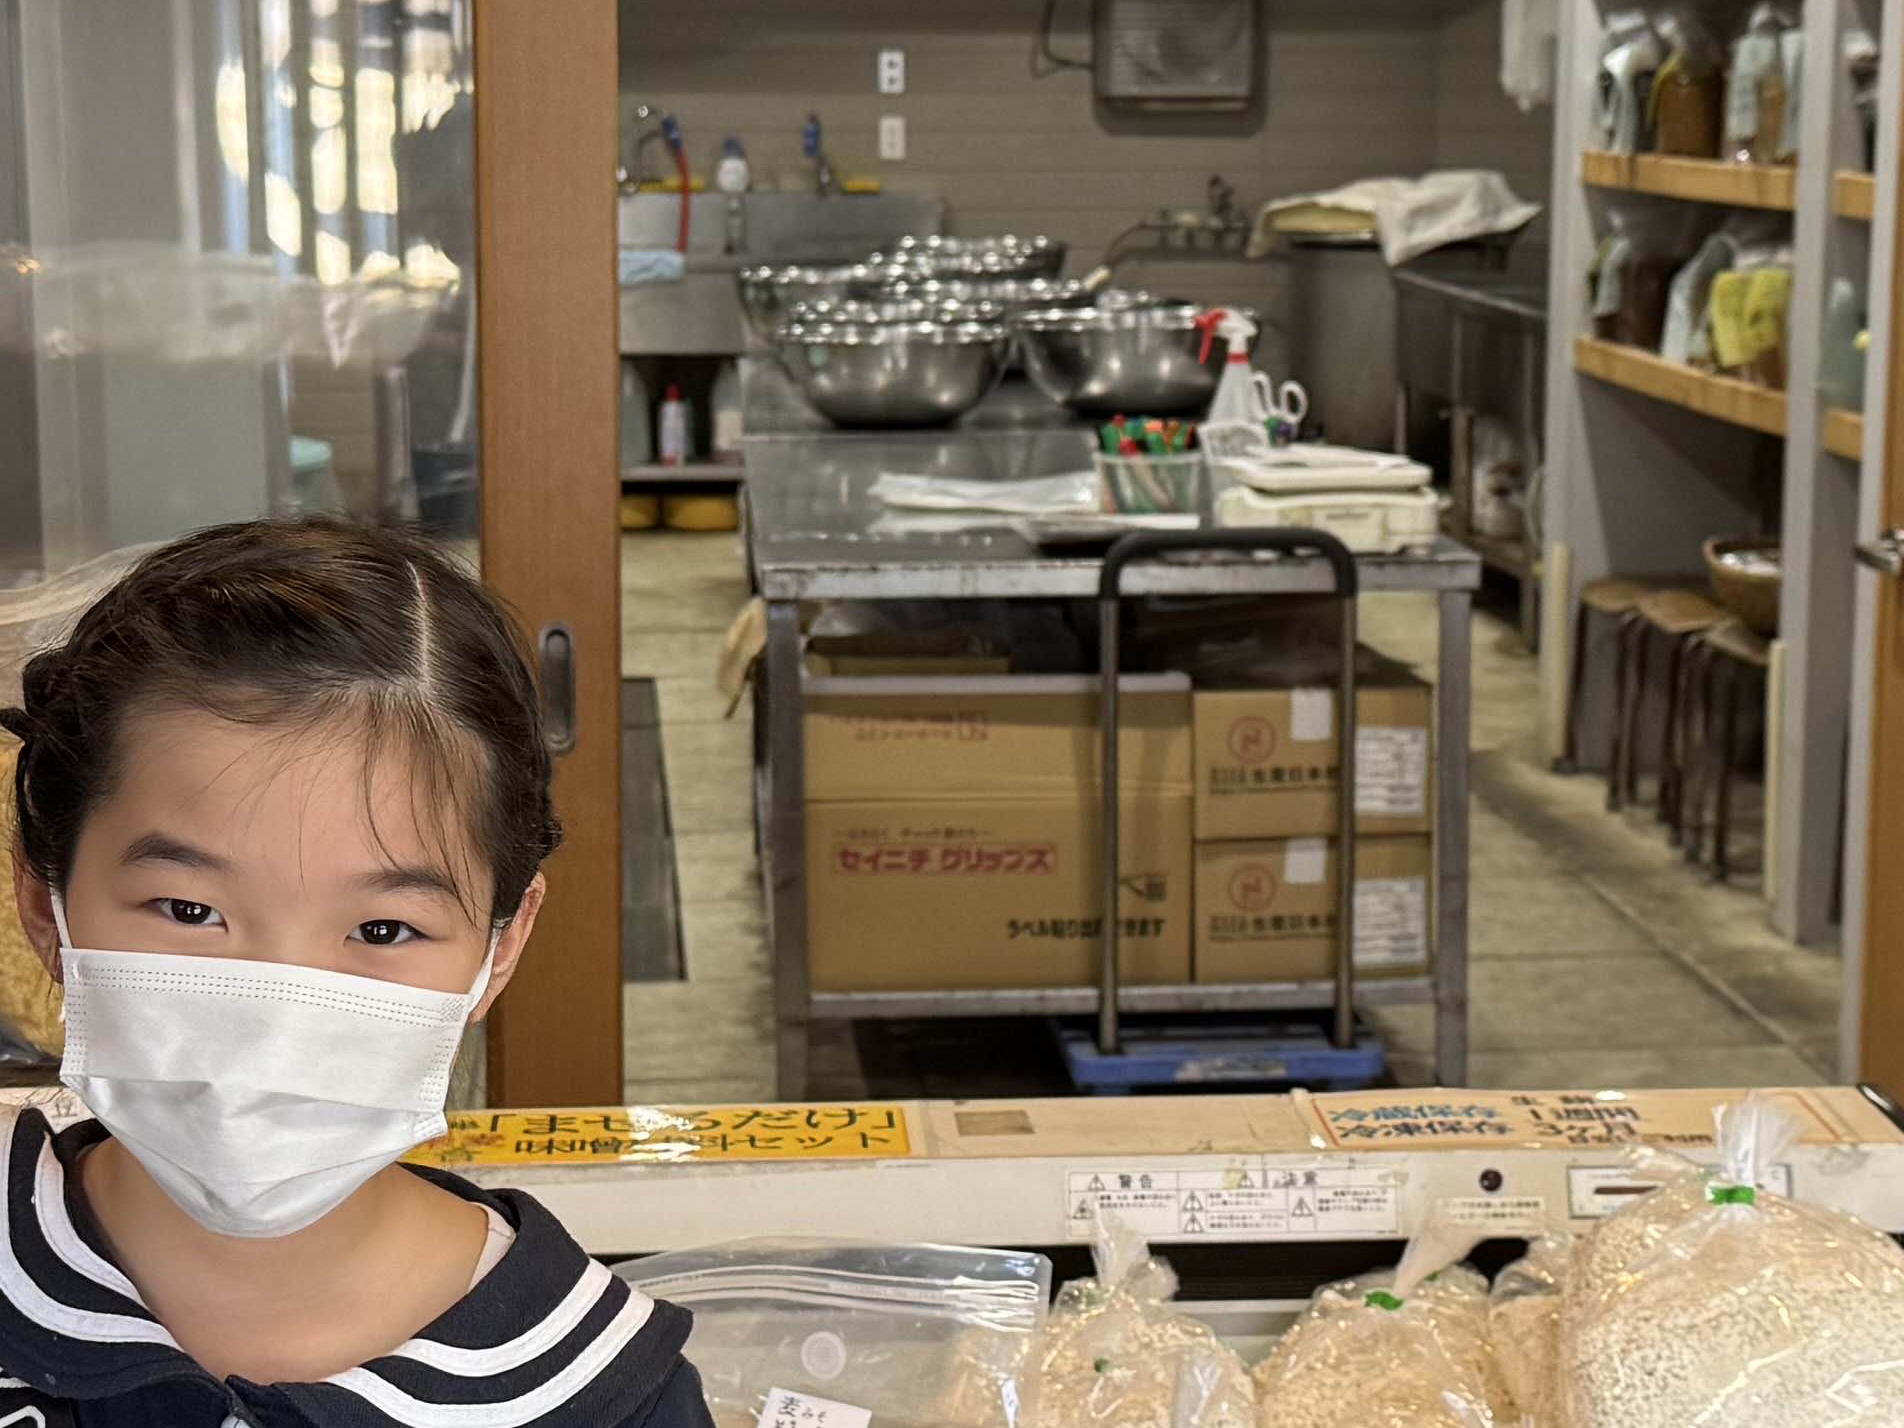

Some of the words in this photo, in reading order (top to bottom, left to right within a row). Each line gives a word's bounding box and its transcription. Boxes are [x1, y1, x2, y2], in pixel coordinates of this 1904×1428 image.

[515, 1131, 891, 1155] 味噌料セット
[1117, 1174, 1153, 1189] 警告
[777, 1395, 830, 1426] 麦みそ
